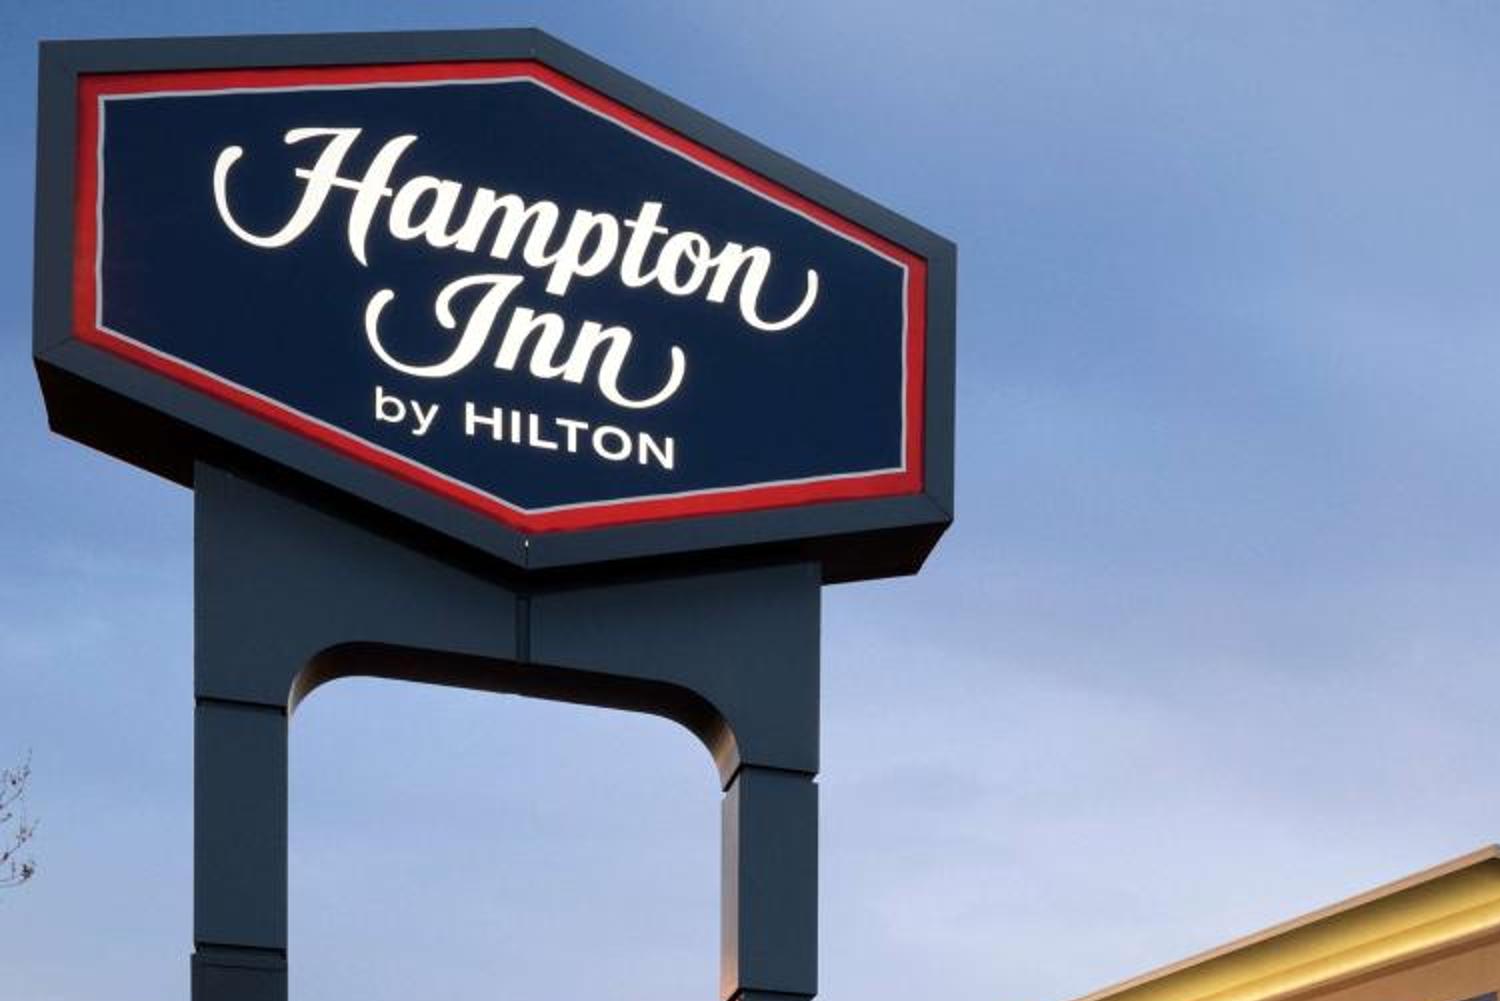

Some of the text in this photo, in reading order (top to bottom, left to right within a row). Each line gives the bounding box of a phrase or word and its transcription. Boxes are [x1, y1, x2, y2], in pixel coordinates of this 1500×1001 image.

[212, 126, 820, 331] Hampton
[365, 273, 686, 409] Inn
[375, 386, 675, 470] by HILTON
